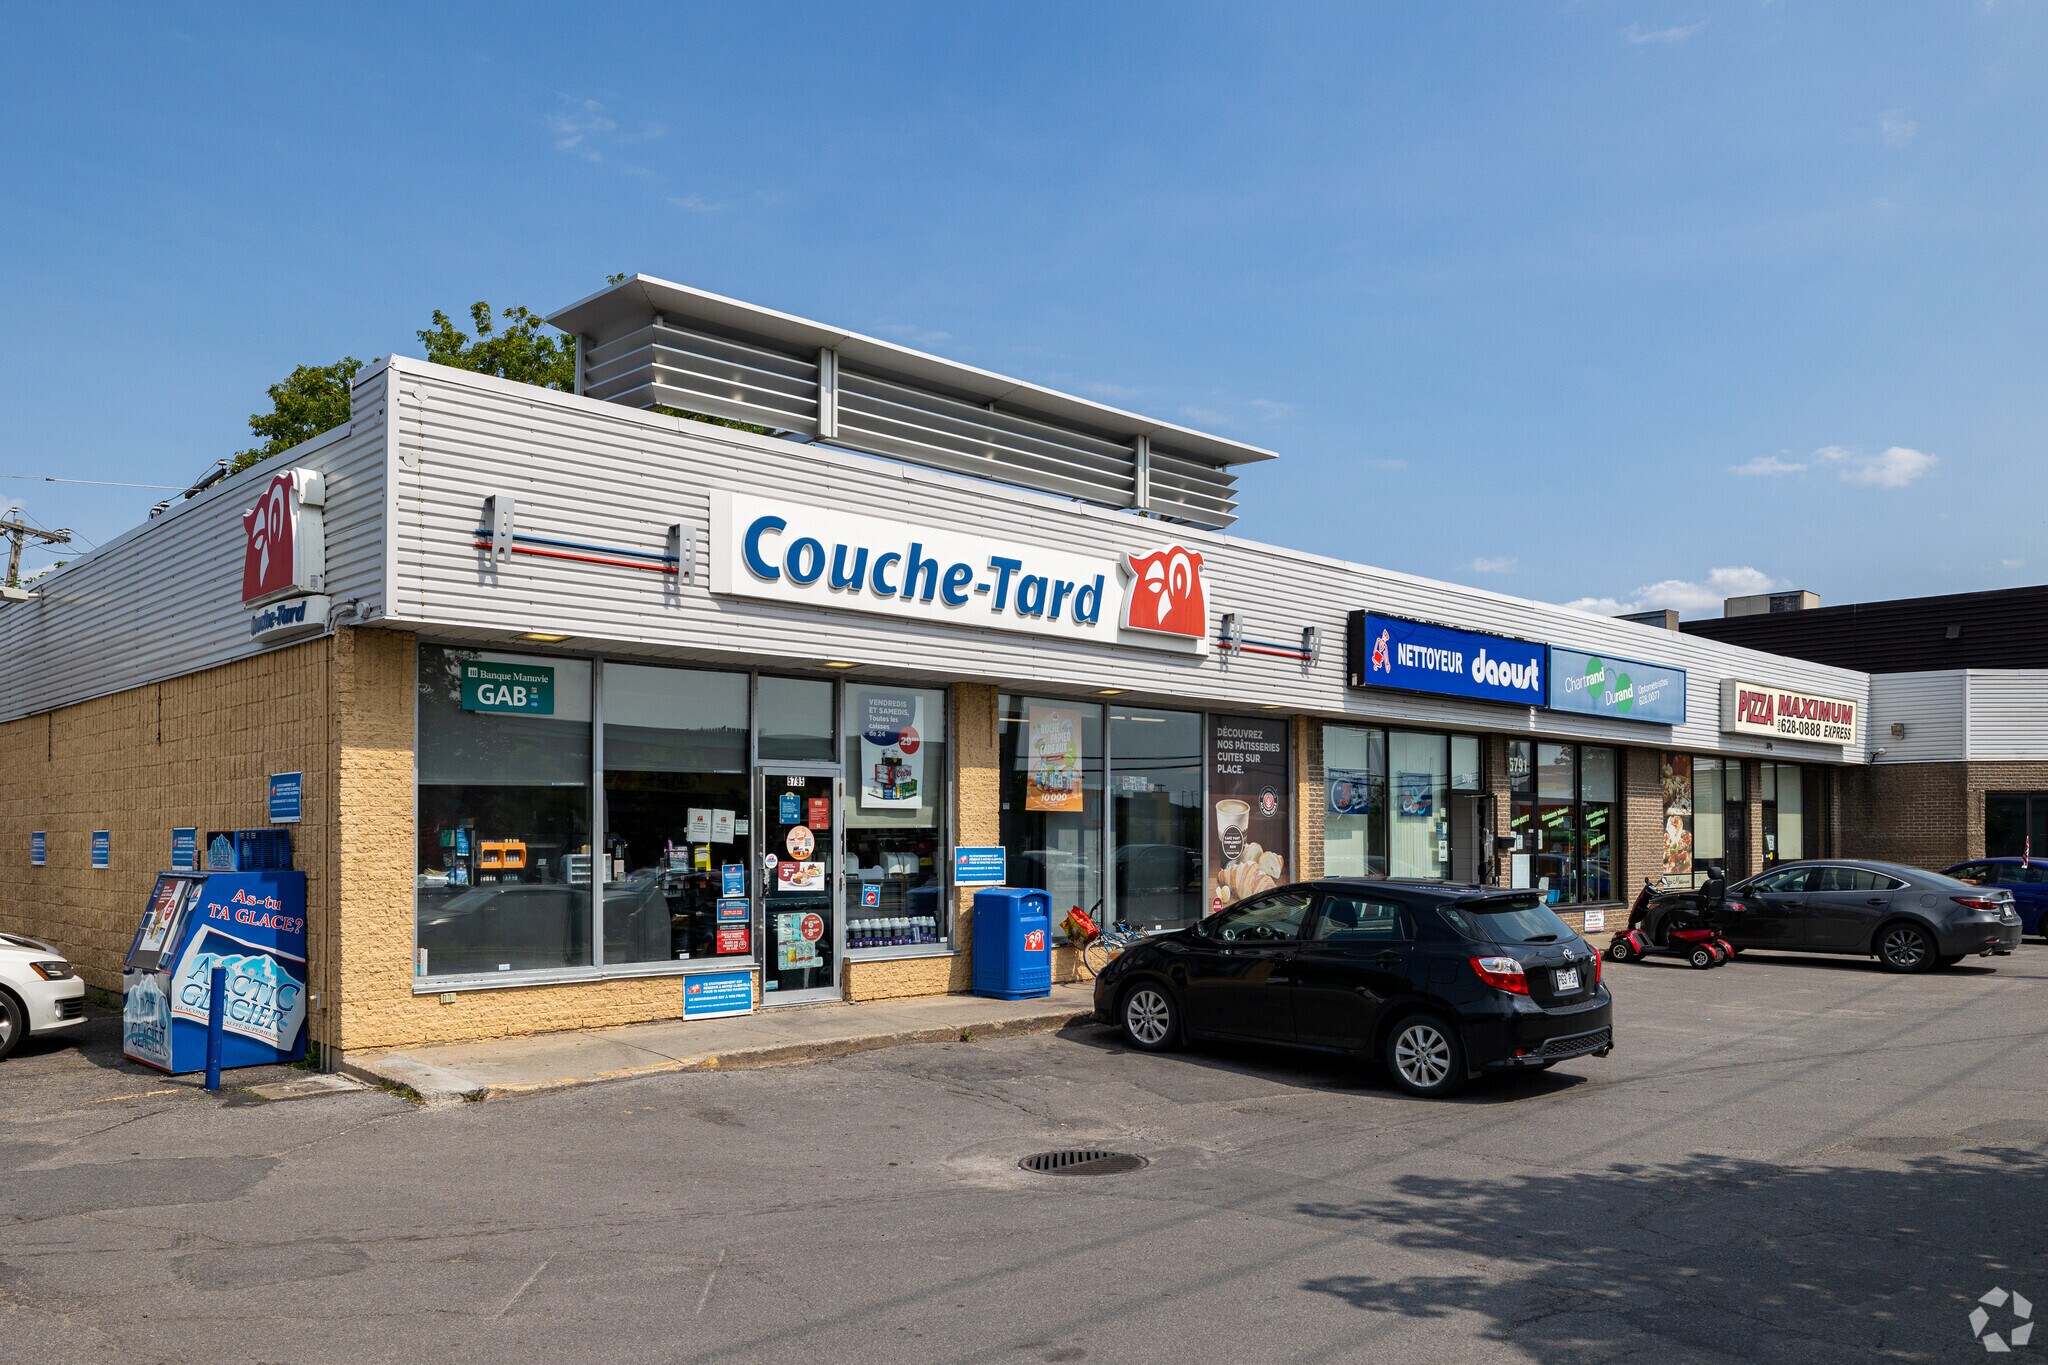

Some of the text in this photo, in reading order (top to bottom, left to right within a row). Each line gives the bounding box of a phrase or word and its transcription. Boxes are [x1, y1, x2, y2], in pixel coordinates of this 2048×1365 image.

[742, 516, 1105, 624] Couche-Tard
[1398, 642, 1539, 692] NETTOYEUR daoust
[480, 670, 549, 683] Banque Manuvie
[1565, 666, 1605, 693] Chartrand
[477, 683, 527, 707] GAB
[1605, 683, 1634, 706] Durand
[868, 698, 907, 707] VENDREDIS
[1738, 689, 1853, 726] PIZZA MAXIMUM
[878, 707, 910, 717] SAMEDIS,
[1041, 723, 1060, 734] ROCHE
[1217, 725, 1263, 740] DÉCOUVREZ
[1781, 718, 1821, 737] 628-0888
[1823, 724, 1852, 740] EXPRESS
[1050, 732, 1071, 743] PAPIER
[1040, 742, 1067, 755] CADEAUX
[1217, 739, 1280, 752] NOS PÂTISSERIES
[1217, 752, 1261, 763] CUITES SUR
[1509, 757, 1528, 772] 5791
[1217, 764, 1244, 774] PLACE.
[787, 776, 805, 786] 5795
[231, 889, 281, 911] As-tu
[208, 902, 304, 934] TA GLACE?
[131, 1022, 167, 1057] GLACIER
